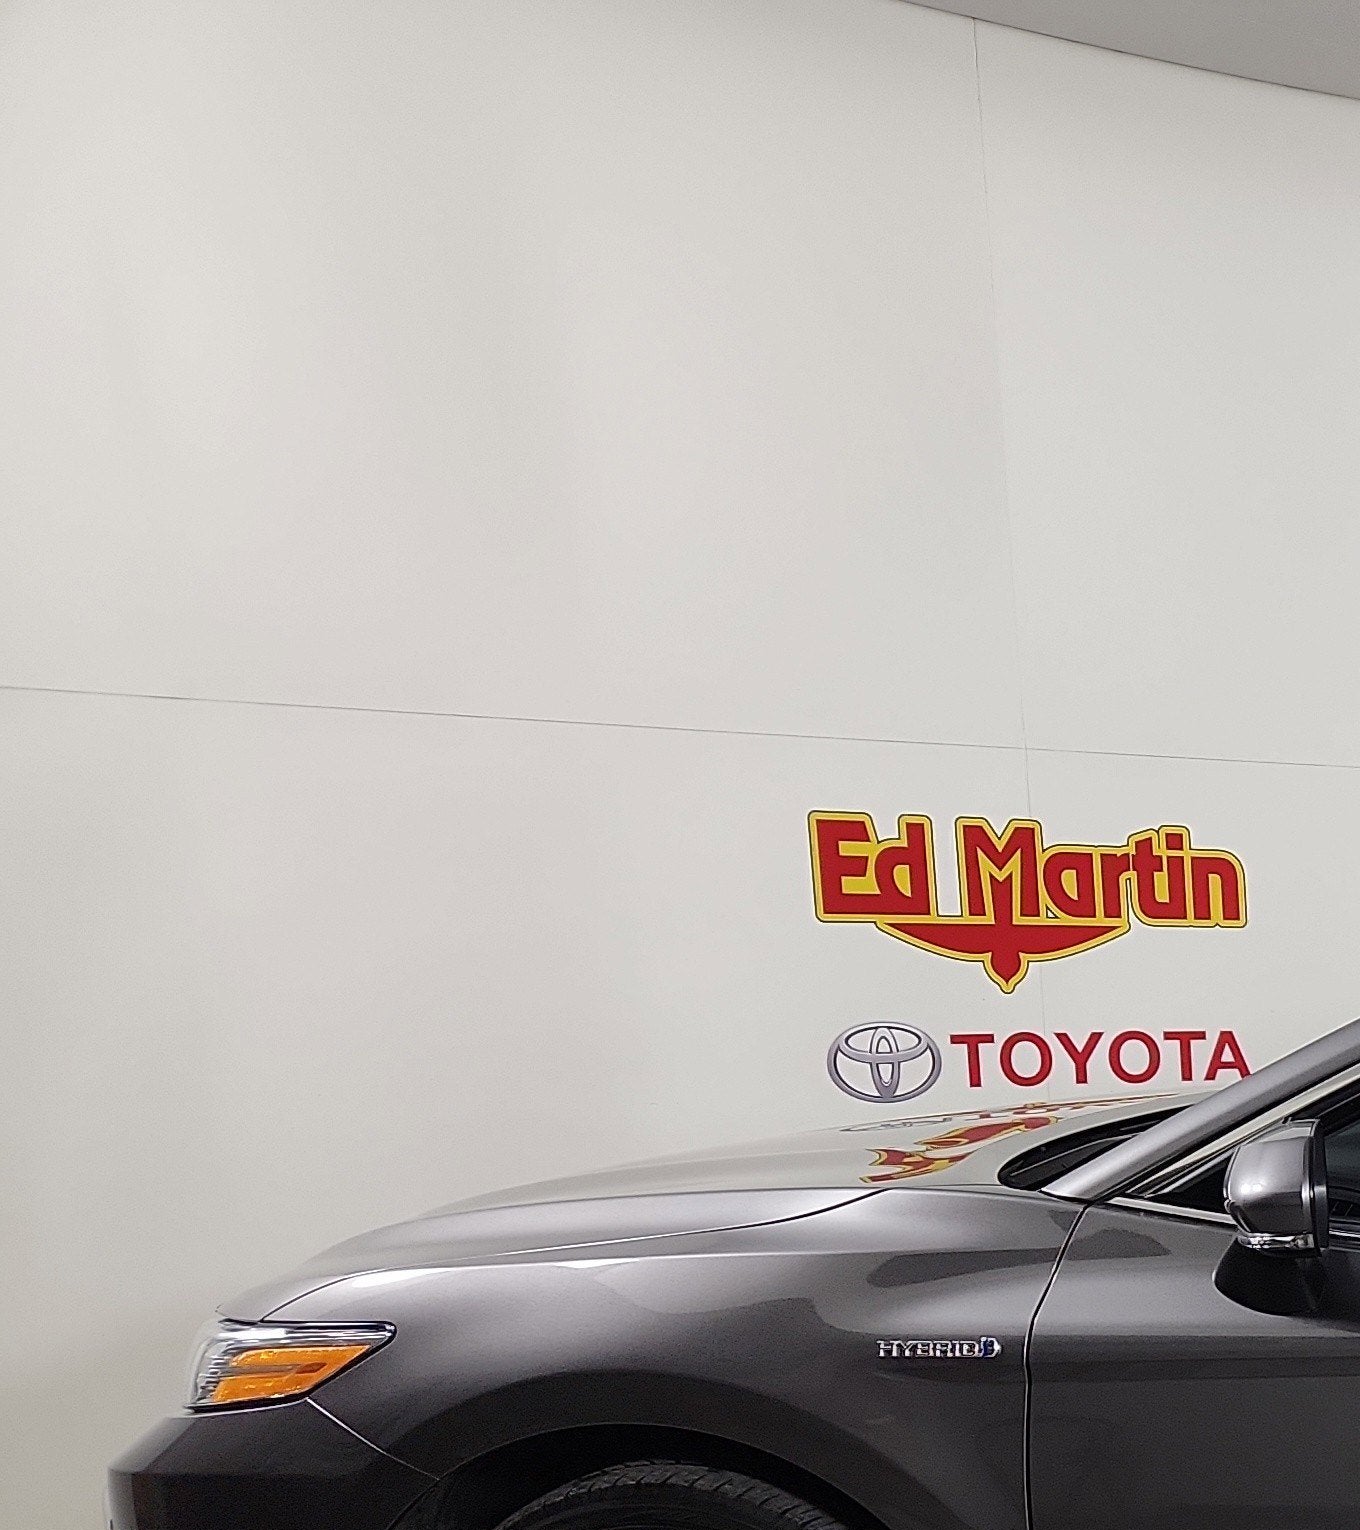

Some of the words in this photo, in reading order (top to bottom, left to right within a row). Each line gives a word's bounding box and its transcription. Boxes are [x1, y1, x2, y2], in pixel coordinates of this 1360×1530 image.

[808, 811, 936, 922] Ed
[955, 816, 1247, 928] Martin
[950, 1031, 1253, 1089] TOYOTA
[877, 1340, 979, 1358] HYBRID
